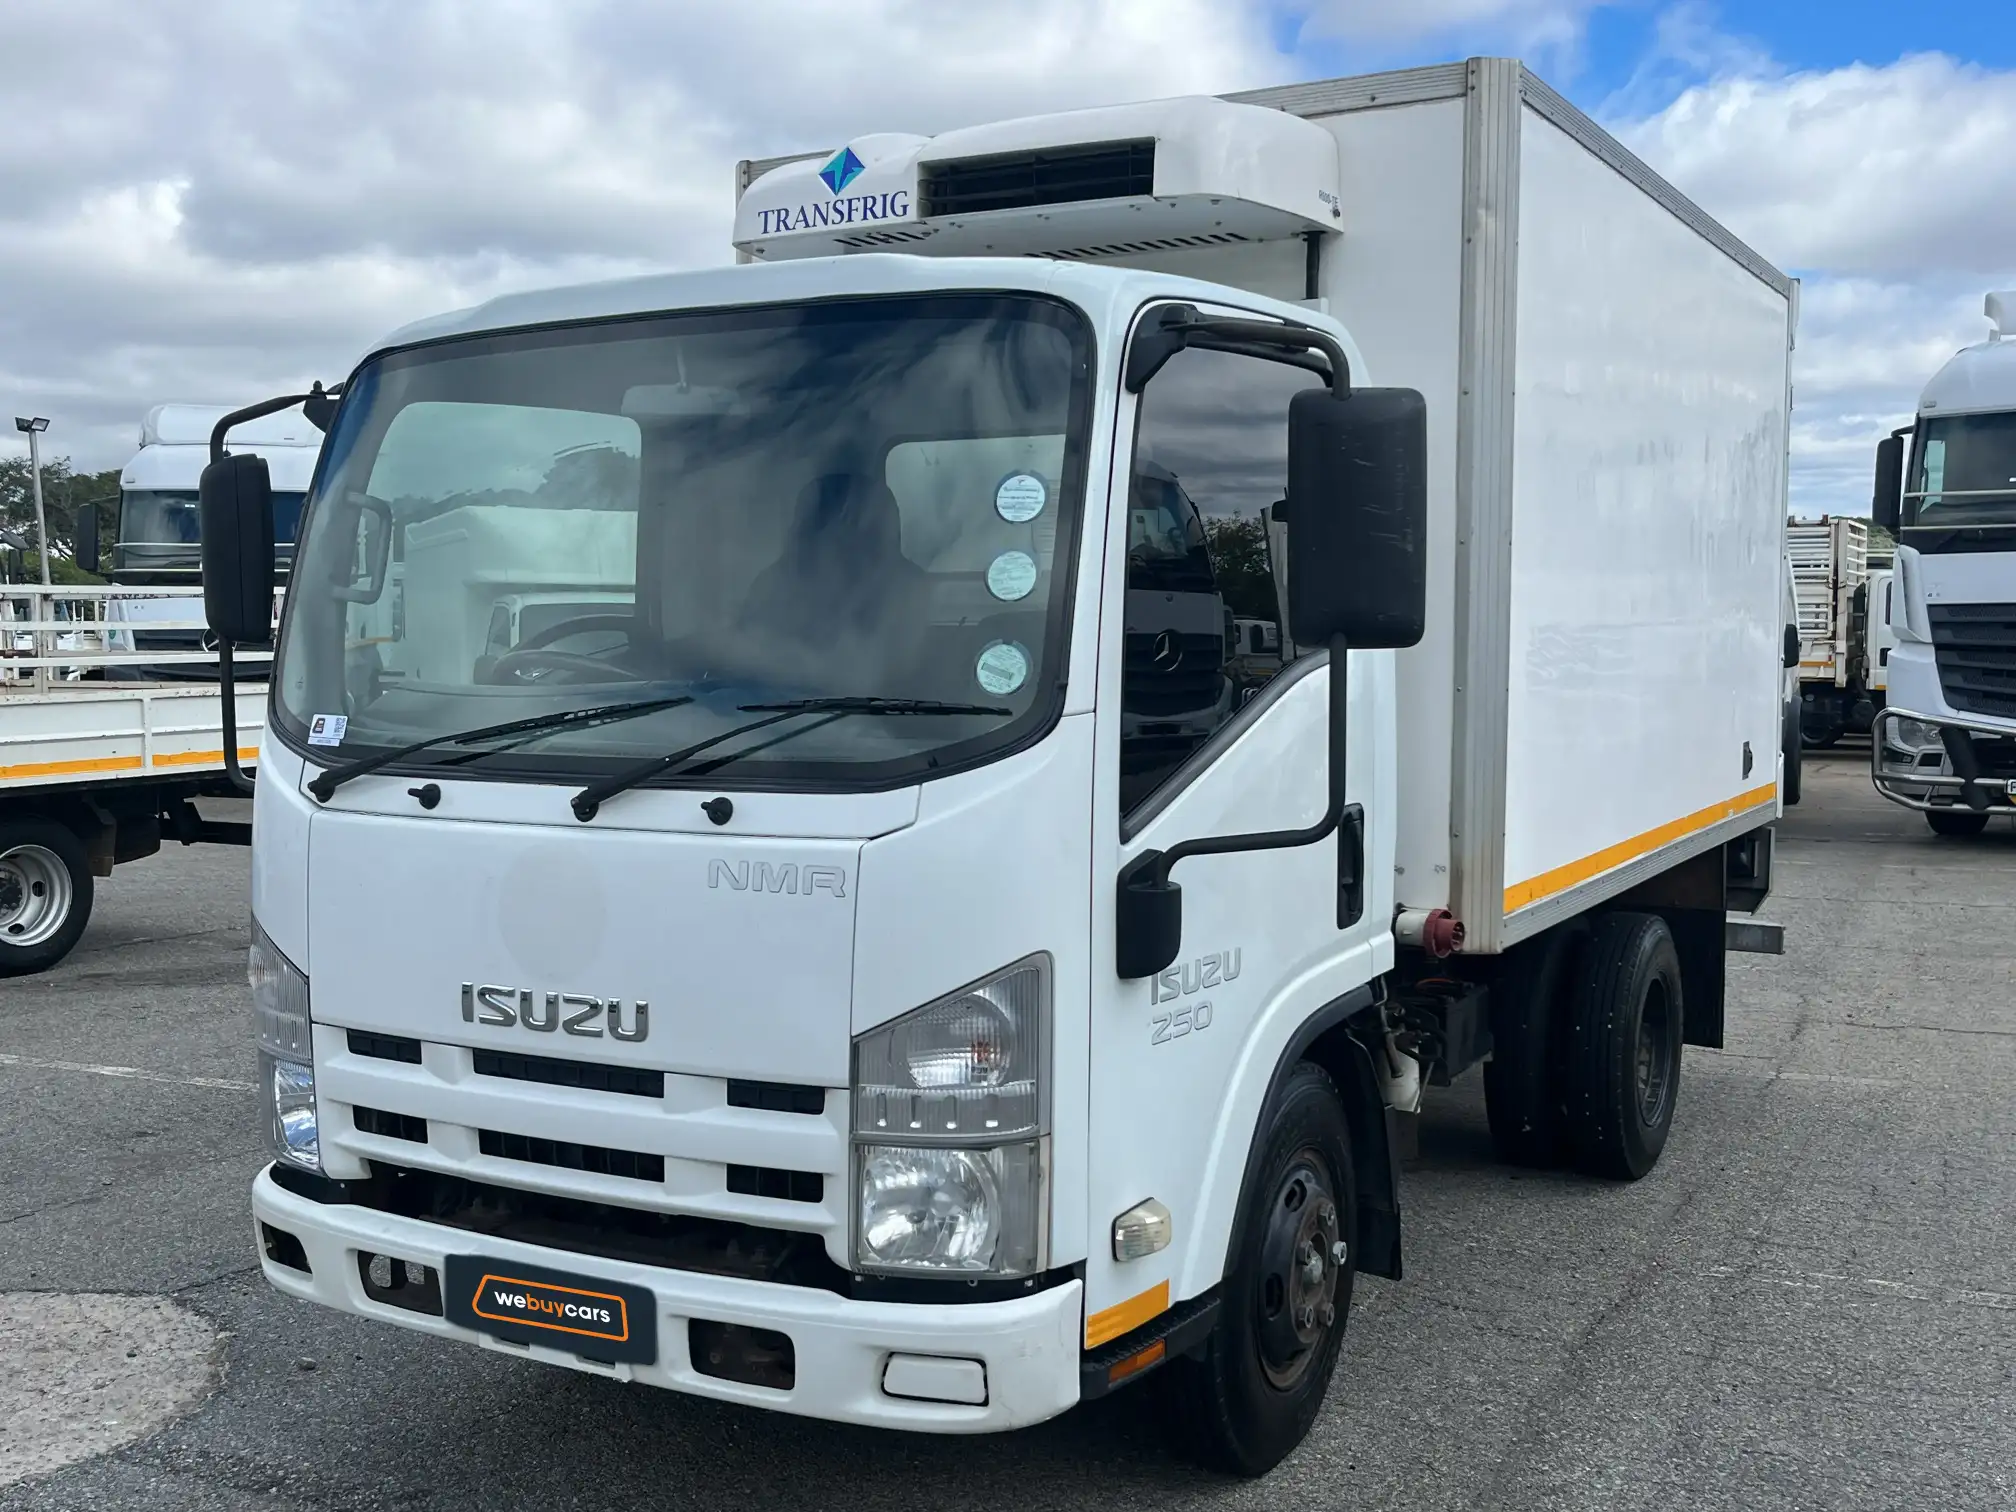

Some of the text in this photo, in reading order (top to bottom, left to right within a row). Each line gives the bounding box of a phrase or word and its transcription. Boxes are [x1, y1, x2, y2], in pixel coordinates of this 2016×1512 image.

[758, 190, 909, 234] TRANSFRIG
[708, 858, 846, 897] NMR
[1151, 947, 1242, 1005] ISUZU
[461, 981, 649, 1042] ISUZU
[1151, 1000, 1213, 1046] 250
[494, 1291, 611, 1323] webuycars
